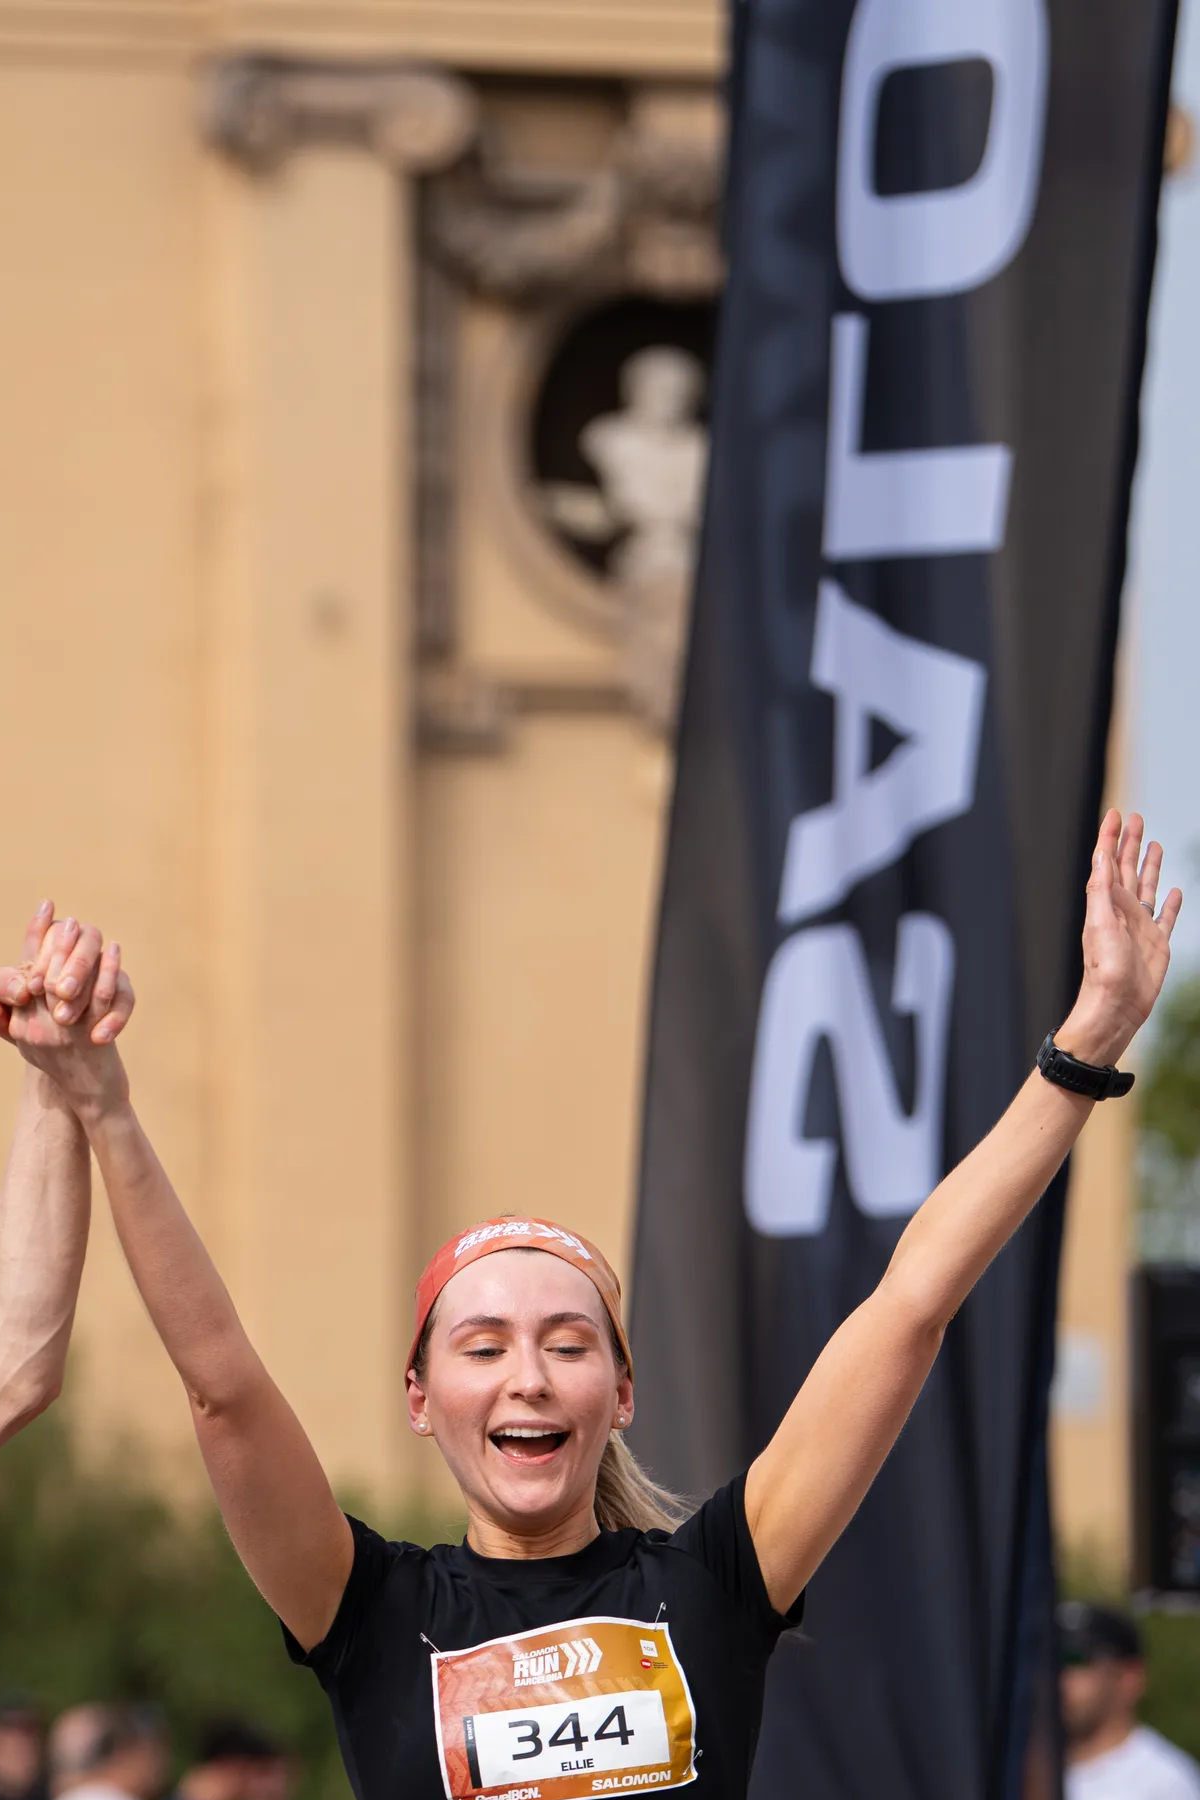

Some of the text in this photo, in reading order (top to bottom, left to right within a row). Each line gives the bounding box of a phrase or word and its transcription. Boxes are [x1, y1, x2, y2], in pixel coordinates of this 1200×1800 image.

[512, 1645, 558, 1661] SALOMON
[513, 1652, 560, 1679] RUN
[514, 1671, 564, 1687] BARCELONA
[508, 1705, 635, 1761] 344
[561, 1758, 594, 1771] ELLIE
[591, 1770, 672, 1791] SALOMON
